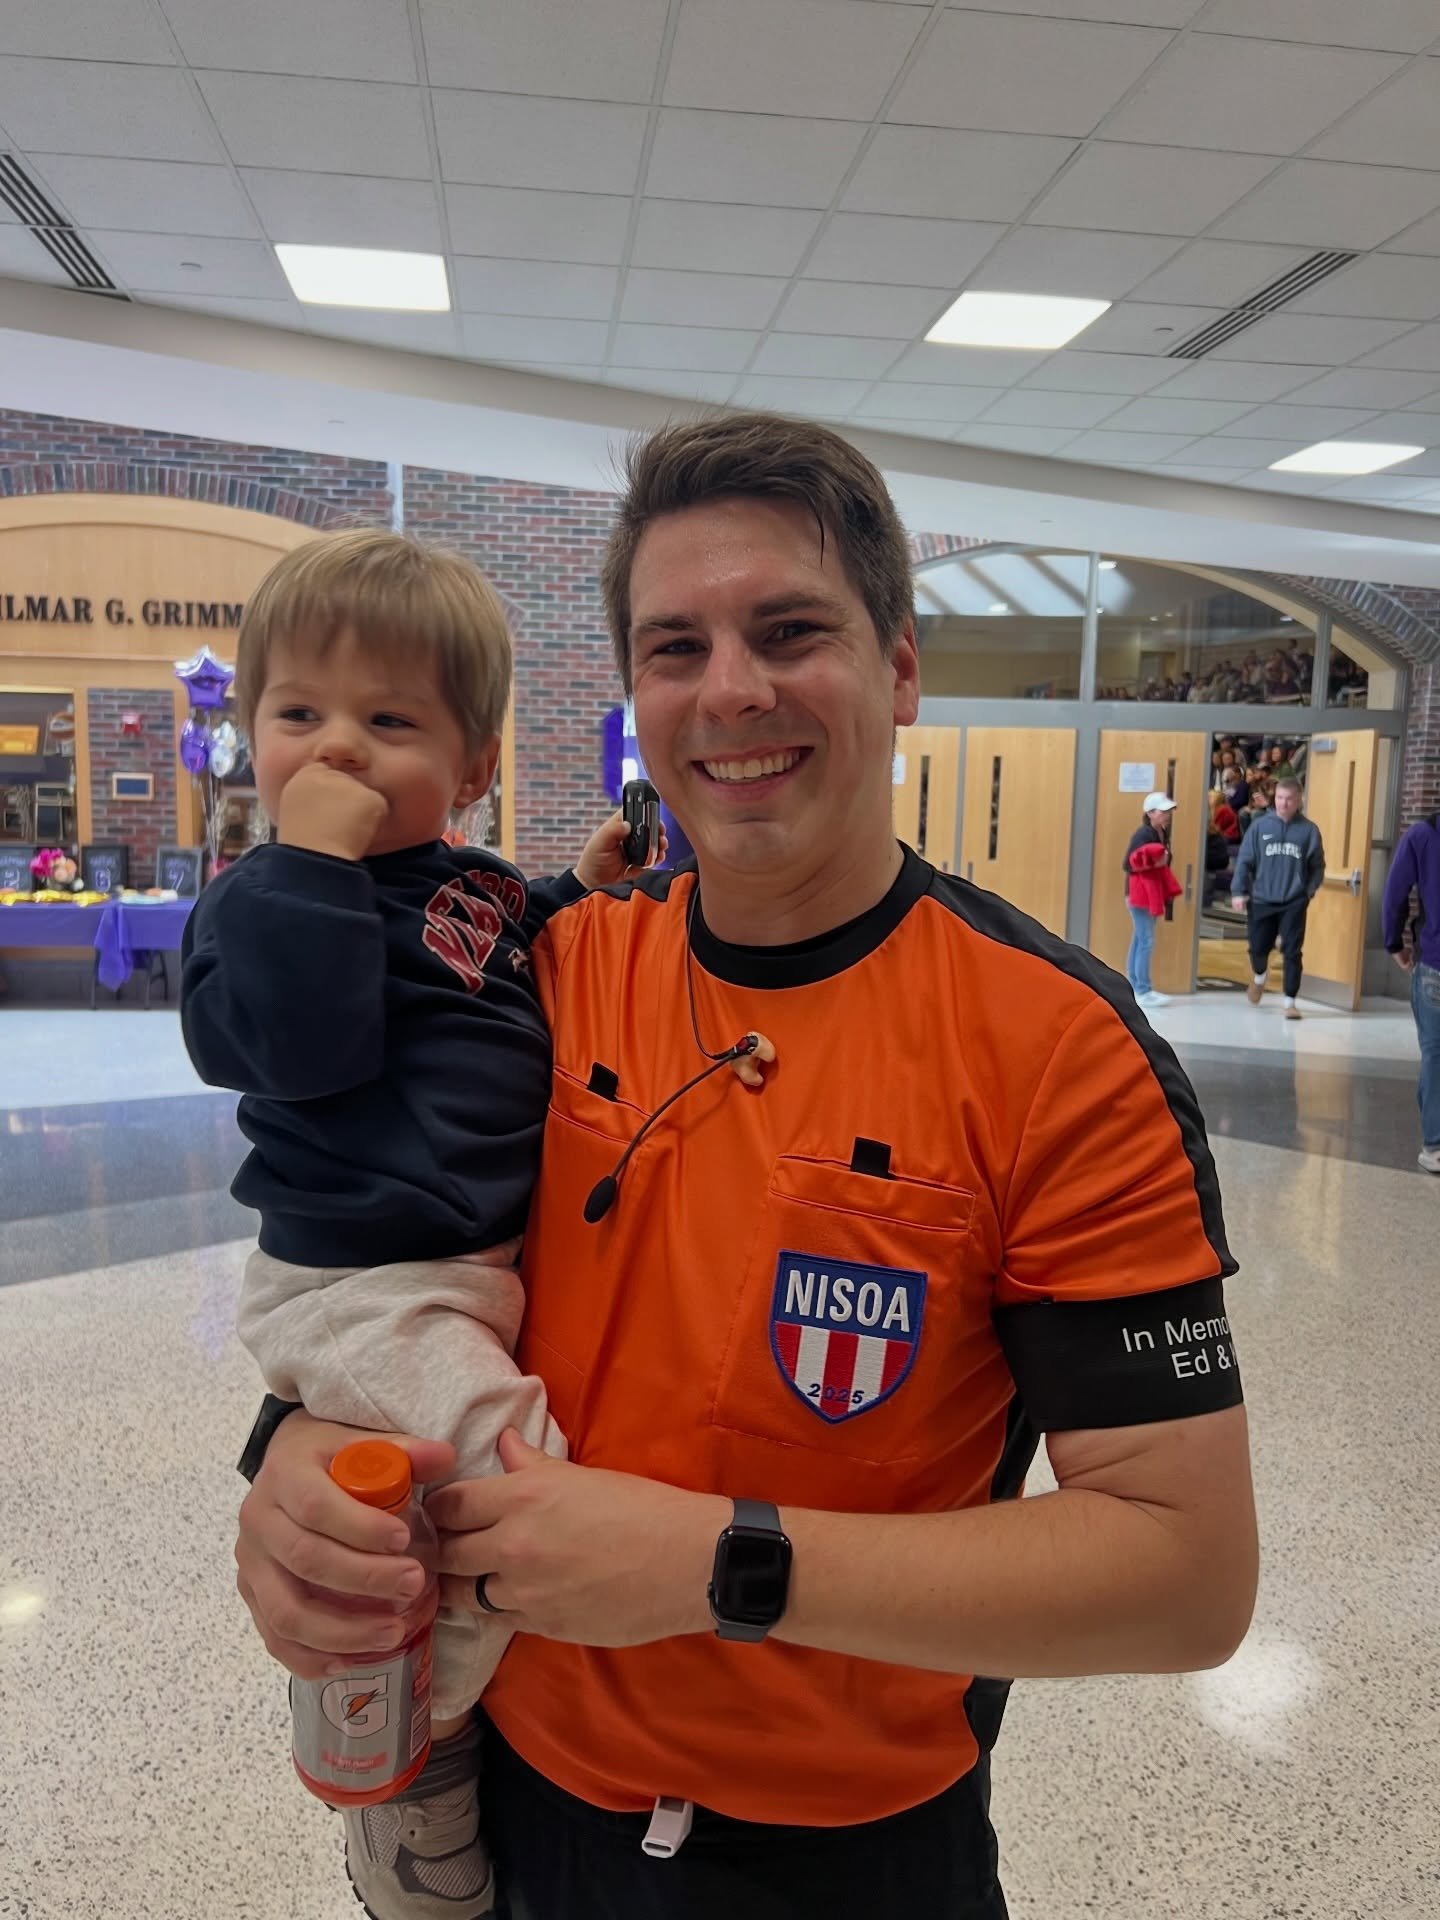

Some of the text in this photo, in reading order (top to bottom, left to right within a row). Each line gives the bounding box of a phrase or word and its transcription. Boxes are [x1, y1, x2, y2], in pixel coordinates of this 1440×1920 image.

[0, 594, 244, 627] LMAR G. GRIMM
[784, 1269, 911, 1332] NISOA
[1122, 1327, 1155, 1352] In
[1171, 1348, 1211, 1379] Ed
[1216, 1344, 1232, 1370] &
[806, 1383, 865, 1404] 2025
[320, 1672, 389, 1739] G
